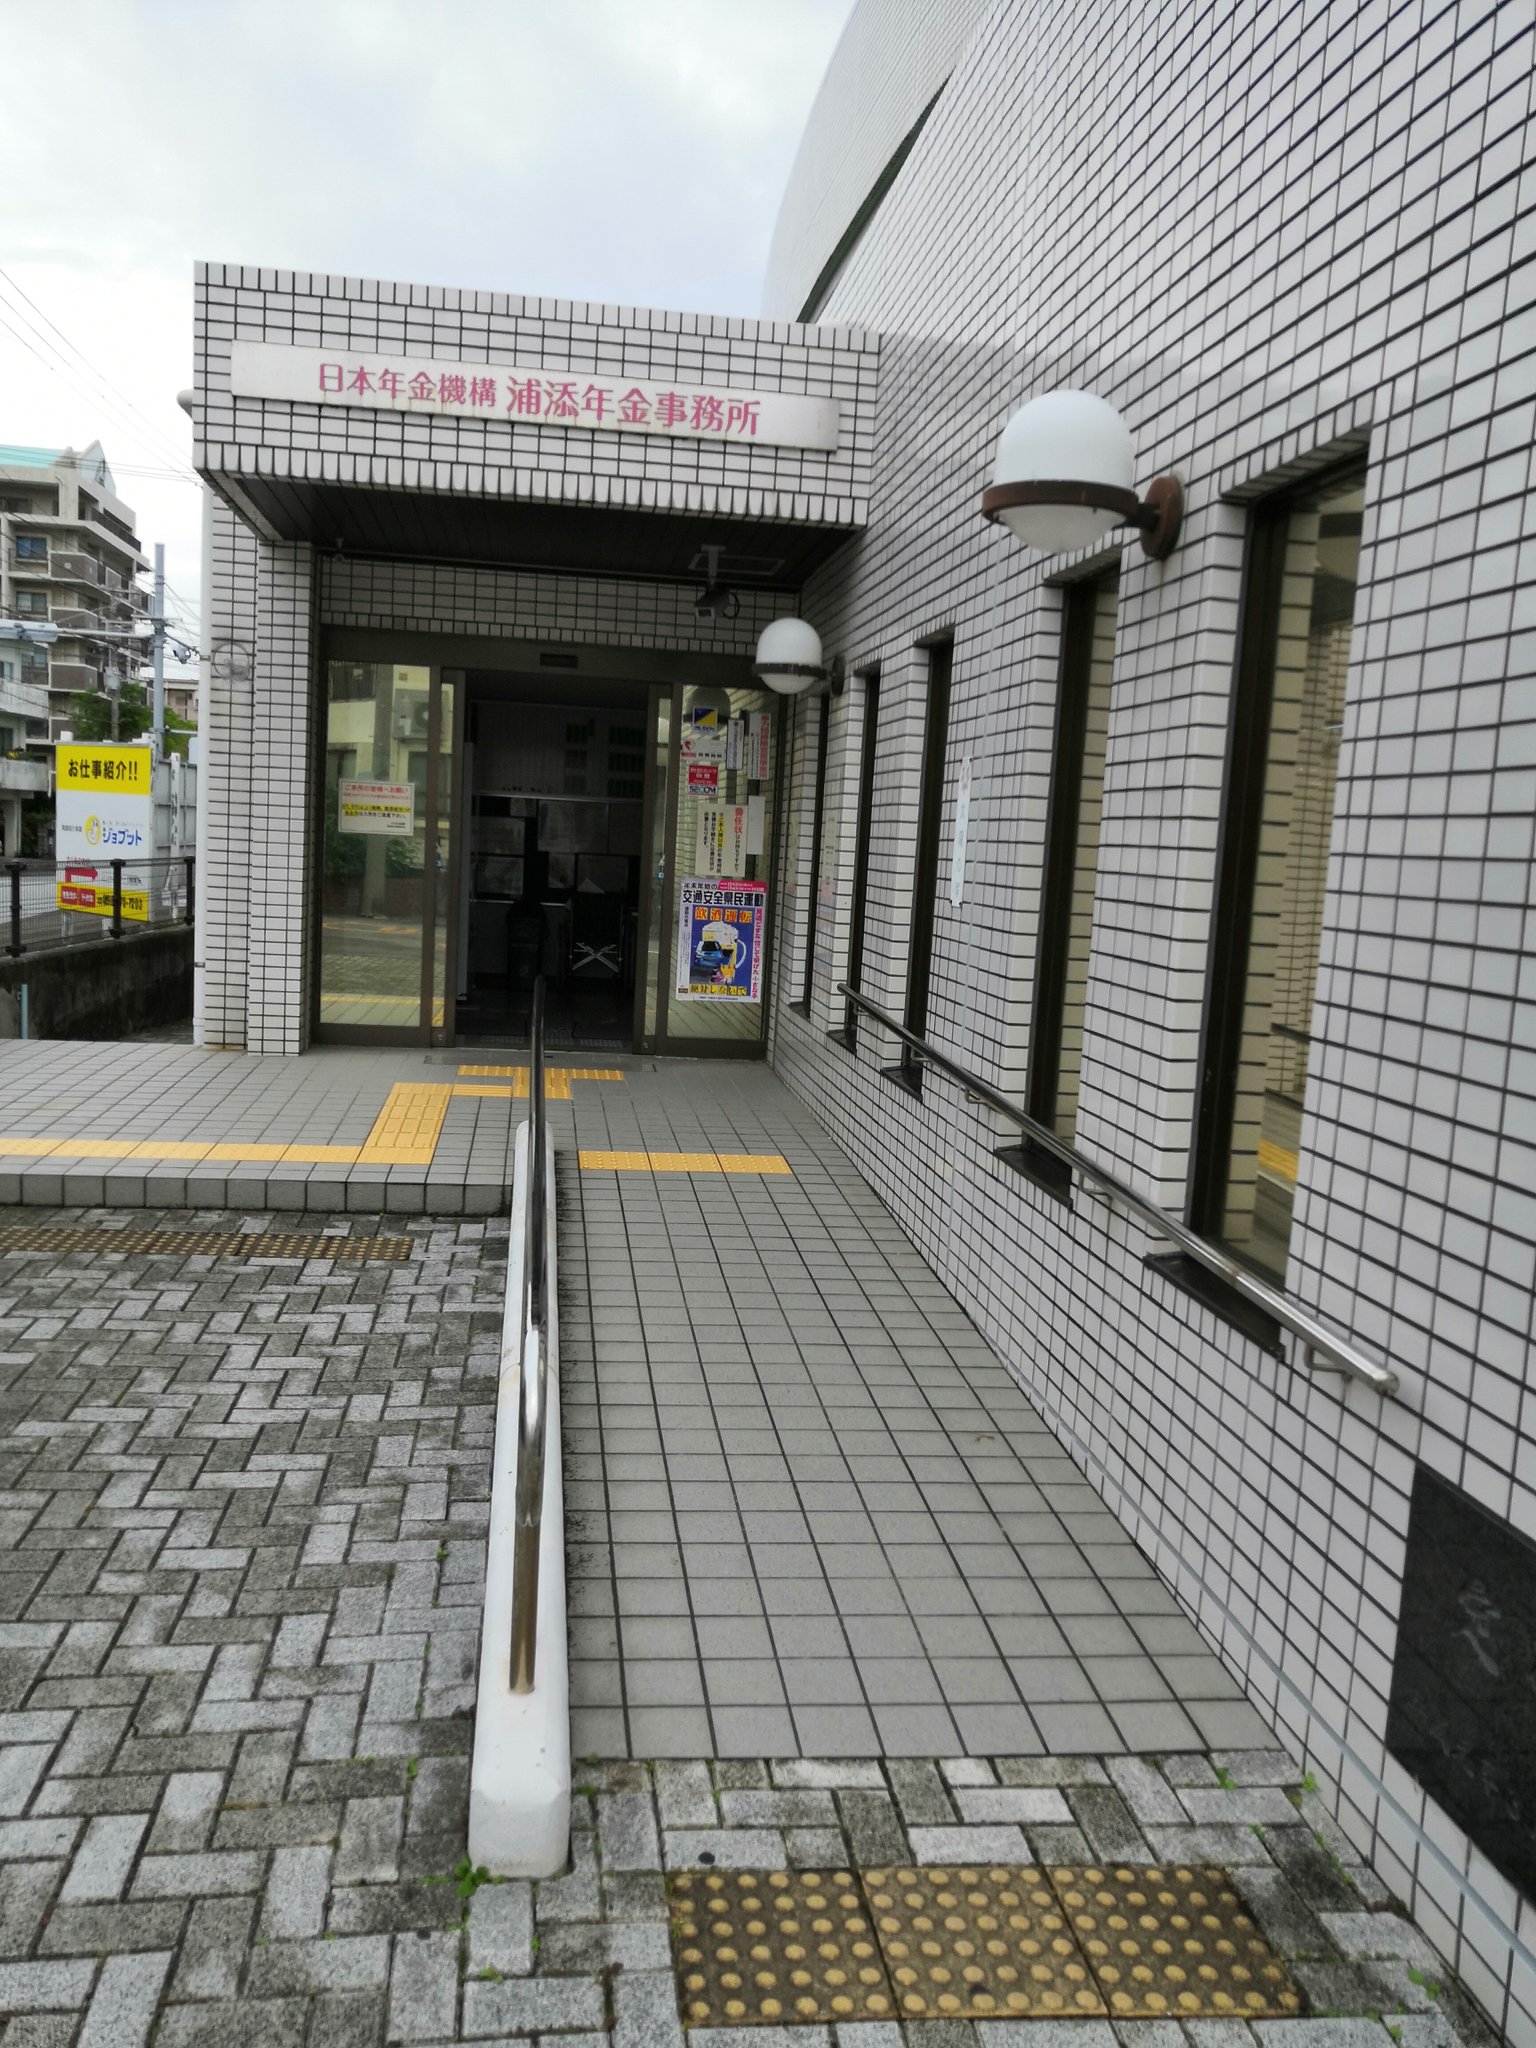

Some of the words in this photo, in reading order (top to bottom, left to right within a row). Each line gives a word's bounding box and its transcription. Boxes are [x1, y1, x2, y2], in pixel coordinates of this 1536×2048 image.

[318, 362, 497, 408] 日本年金機構
[507, 376, 761, 436] 浦添年金事務所
[689, 785, 716, 794] SECOM
[682, 889, 765, 907] 交通安全県民運動
[694, 906, 753, 924] 飲酒運転
